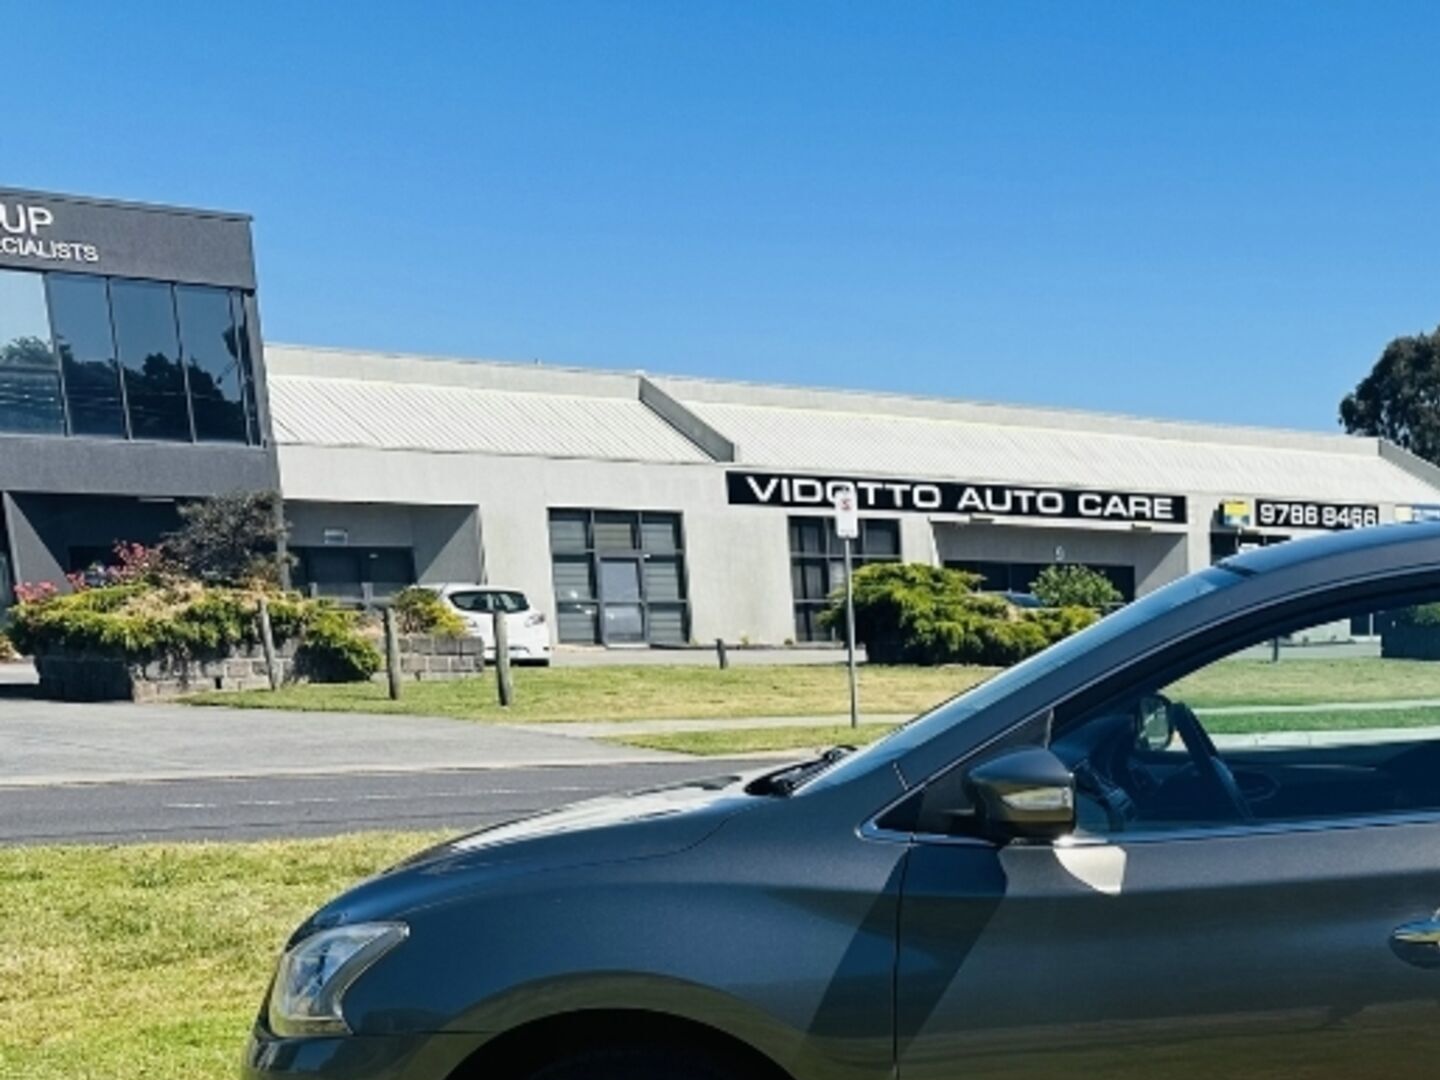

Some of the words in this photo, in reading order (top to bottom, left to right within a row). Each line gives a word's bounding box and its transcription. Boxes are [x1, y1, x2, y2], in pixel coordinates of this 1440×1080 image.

[745, 476, 941, 508] VIDOTTO
[957, 487, 1064, 514] AUTO
[1078, 493, 1174, 519] CARE
